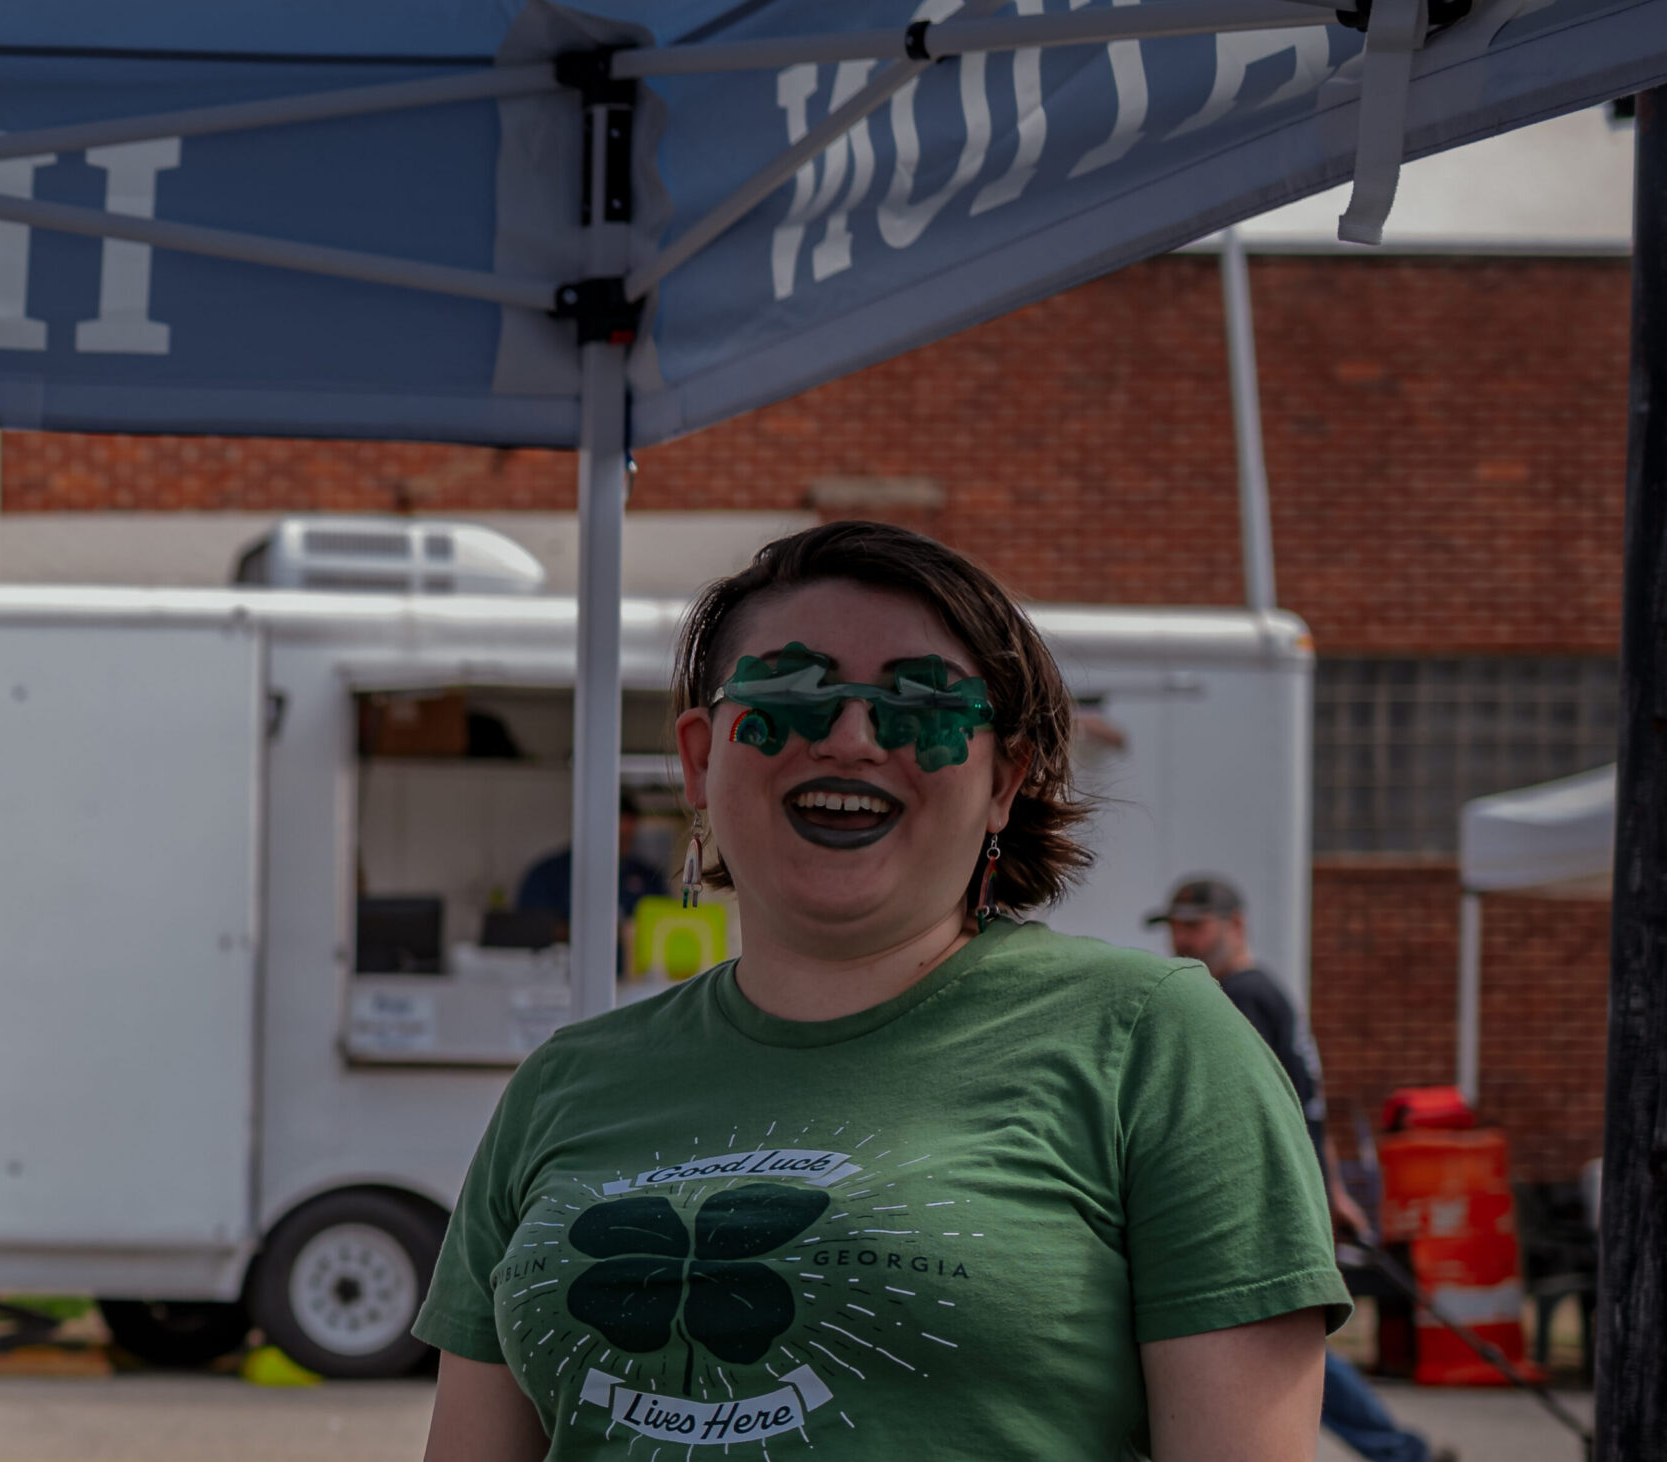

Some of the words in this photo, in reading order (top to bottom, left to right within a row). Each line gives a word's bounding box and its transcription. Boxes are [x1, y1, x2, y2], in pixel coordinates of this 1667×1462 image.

[646, 1154, 748, 1185] Good
[748, 1149, 834, 1177] Luck
[491, 1256, 548, 1289] UBLIN
[812, 1249, 969, 1280] GEORGIA
[623, 1392, 696, 1435] Lives
[700, 1402, 794, 1441] Here
